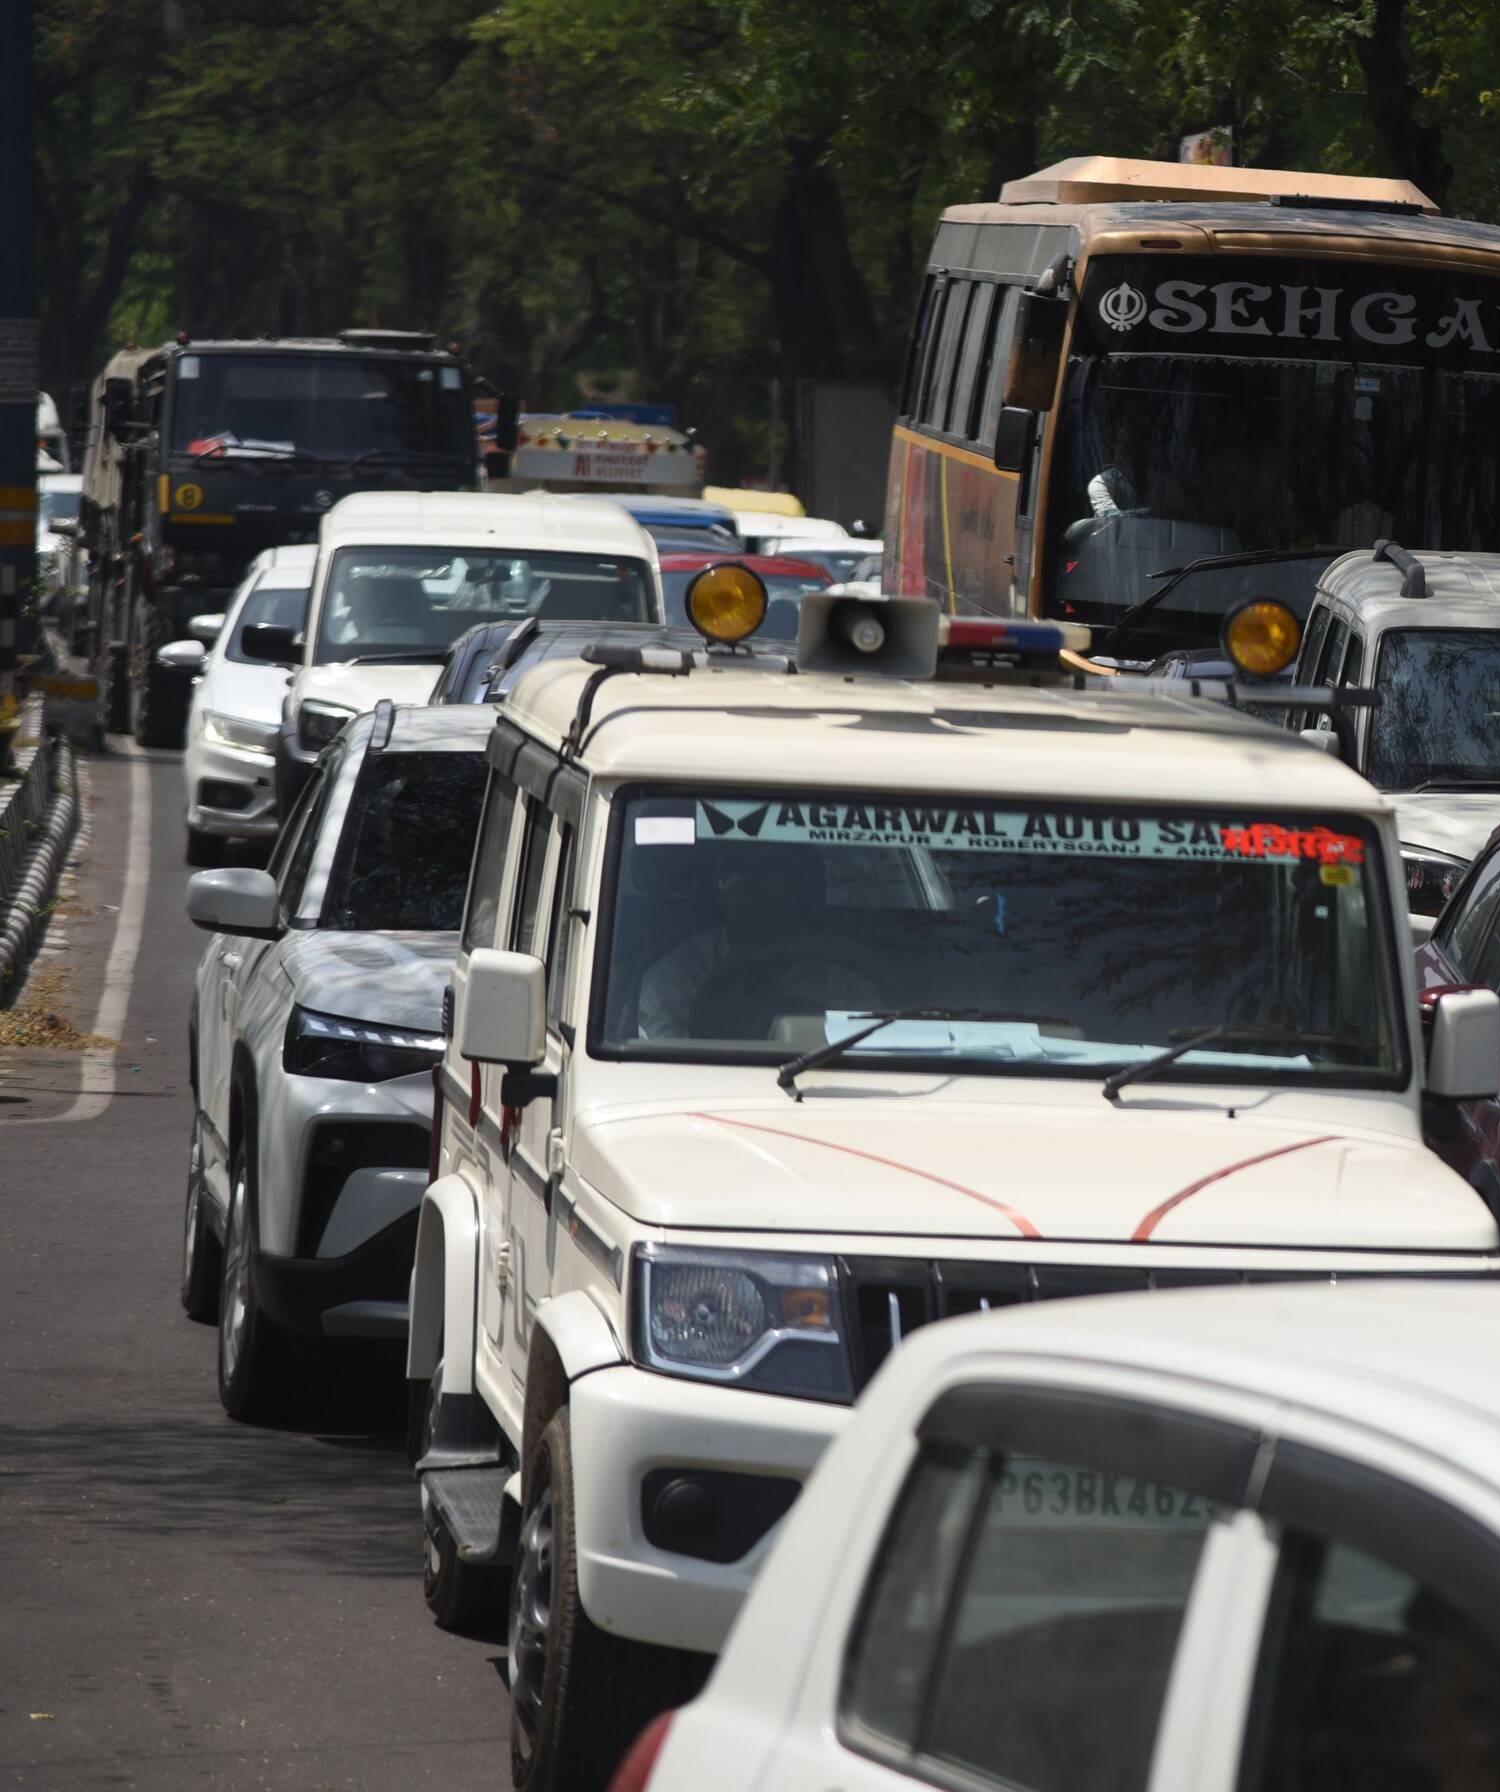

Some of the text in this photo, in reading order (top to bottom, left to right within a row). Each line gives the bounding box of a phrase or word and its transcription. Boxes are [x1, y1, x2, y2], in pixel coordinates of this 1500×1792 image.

[776, 801, 1006, 838] AGARWAL
[1022, 811, 1140, 842] AUTO
[809, 829, 931, 845] MIRZAPUR
[968, 837, 1140, 854] ROBERTSGANJ
